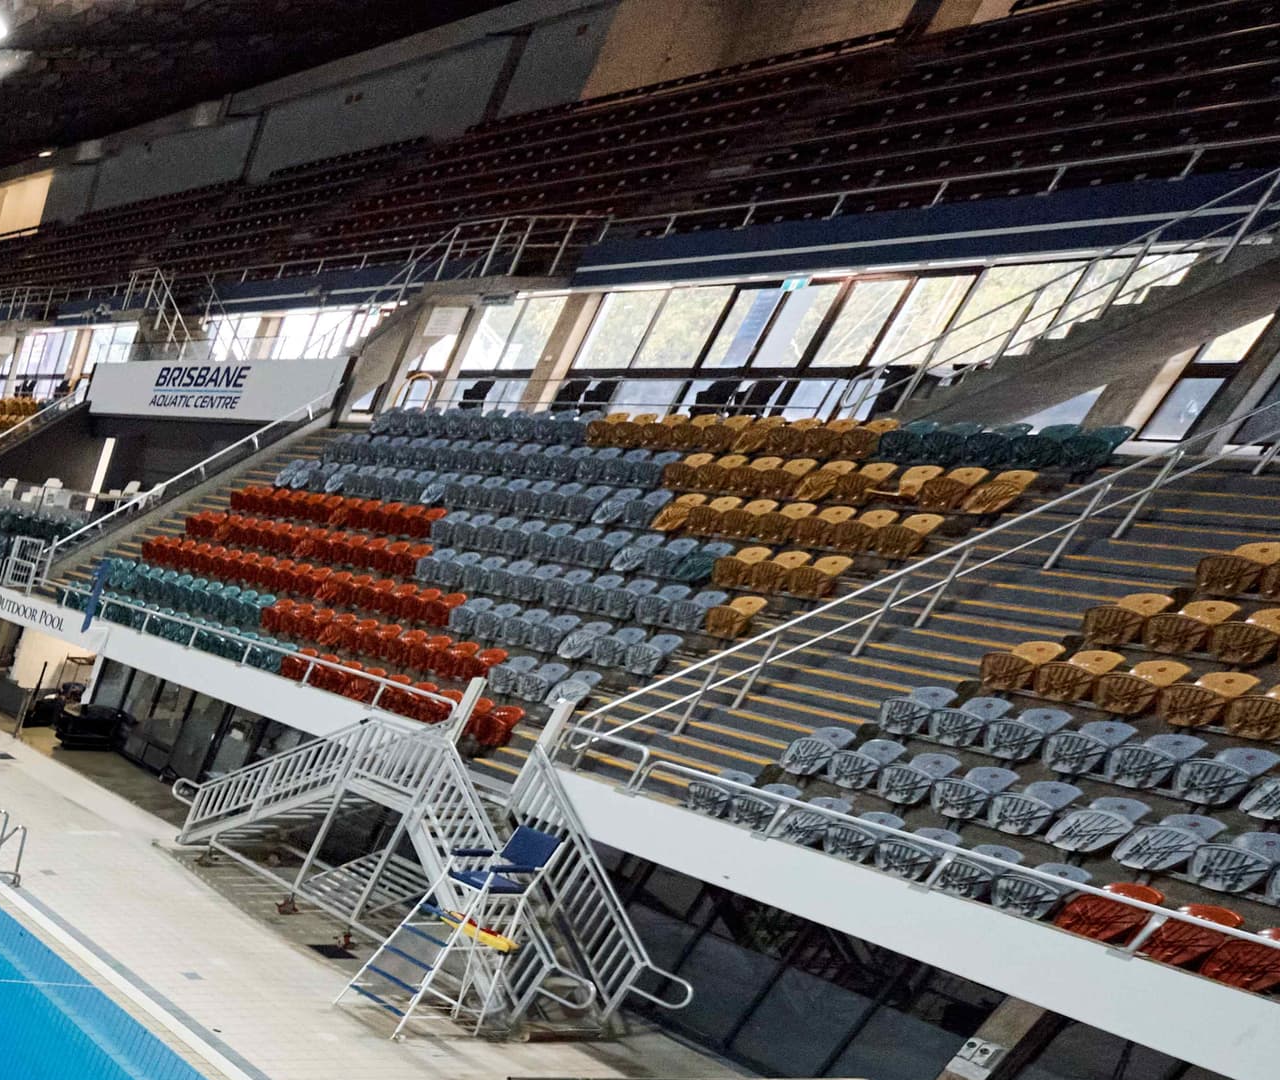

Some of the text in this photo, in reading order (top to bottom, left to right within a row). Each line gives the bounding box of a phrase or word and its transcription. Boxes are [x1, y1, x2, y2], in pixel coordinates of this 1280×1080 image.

[154, 366, 252, 388] BRISBANE
[149, 394, 241, 410] AQUATIC CENTRE
[39, 610, 65, 633] POOL
